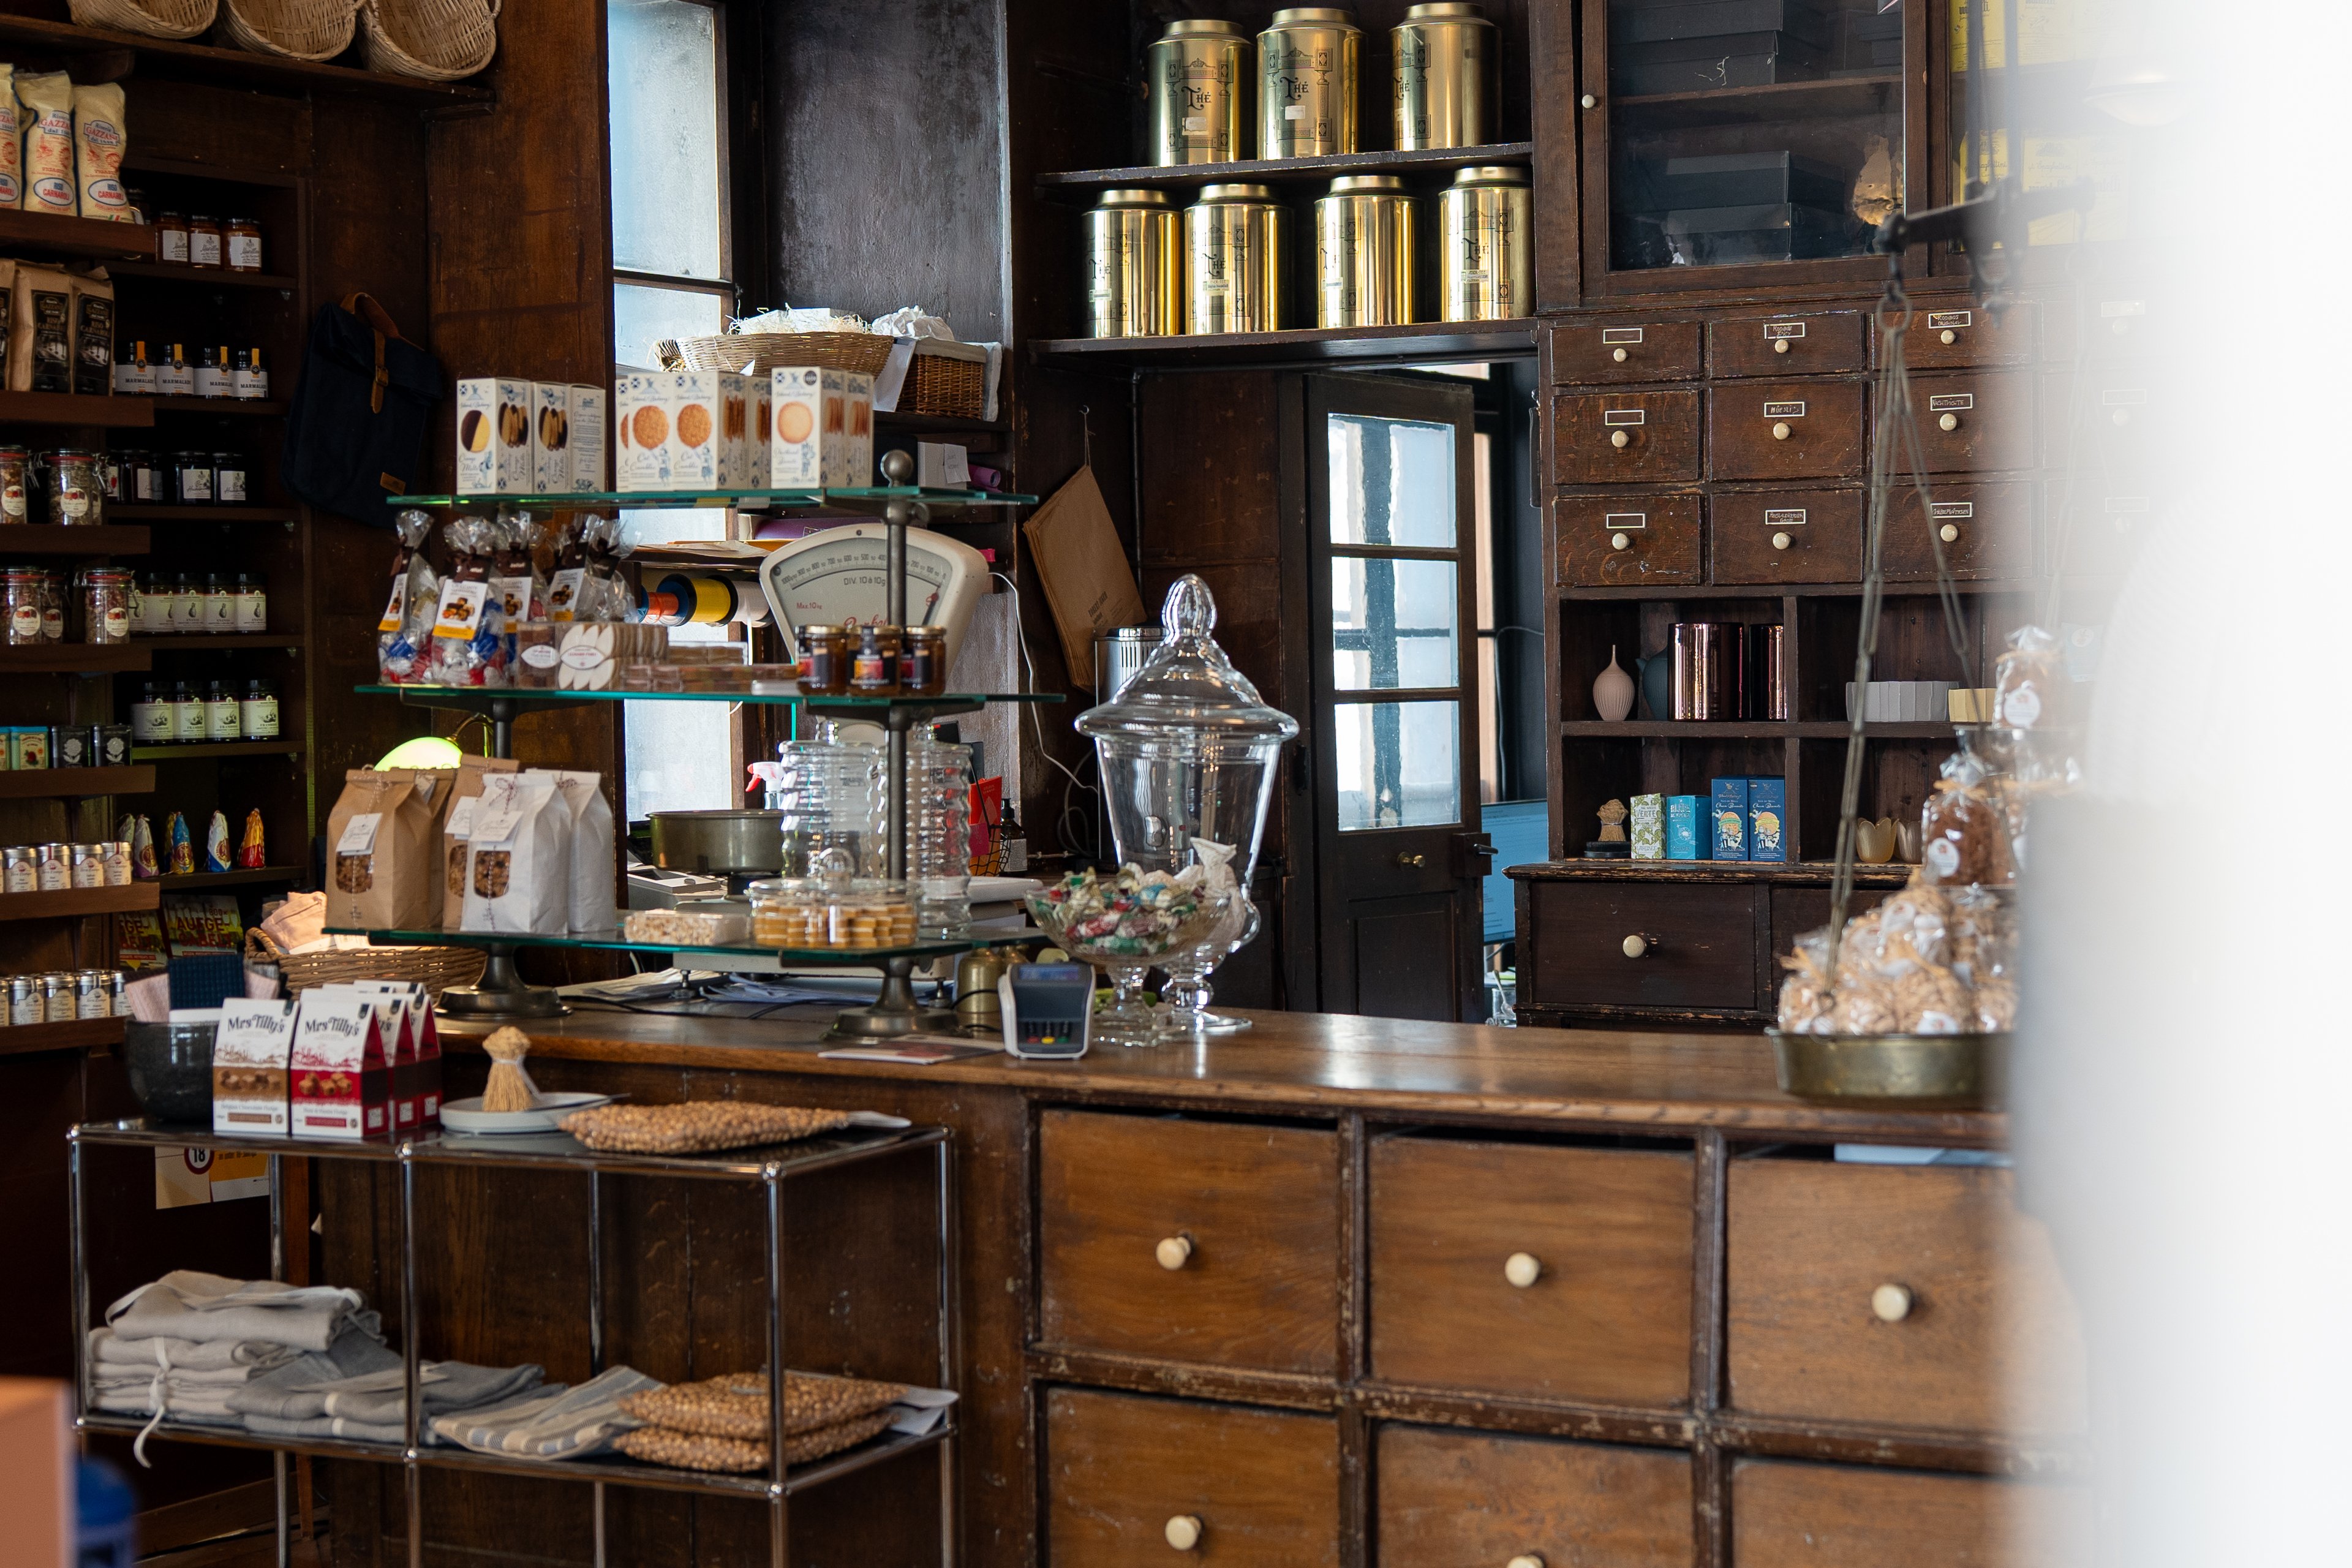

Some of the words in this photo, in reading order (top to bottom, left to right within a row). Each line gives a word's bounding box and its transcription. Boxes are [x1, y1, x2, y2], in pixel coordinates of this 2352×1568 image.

[1636, 809, 1657, 818] VERTE
[227, 1015, 252, 1033] Mrs
[252, 1014, 286, 1033] Tilly's
[306, 1019, 329, 1035] Mrs
[328, 1016, 360, 1037] Tilly's
[192, 1147, 206, 1163] 18
